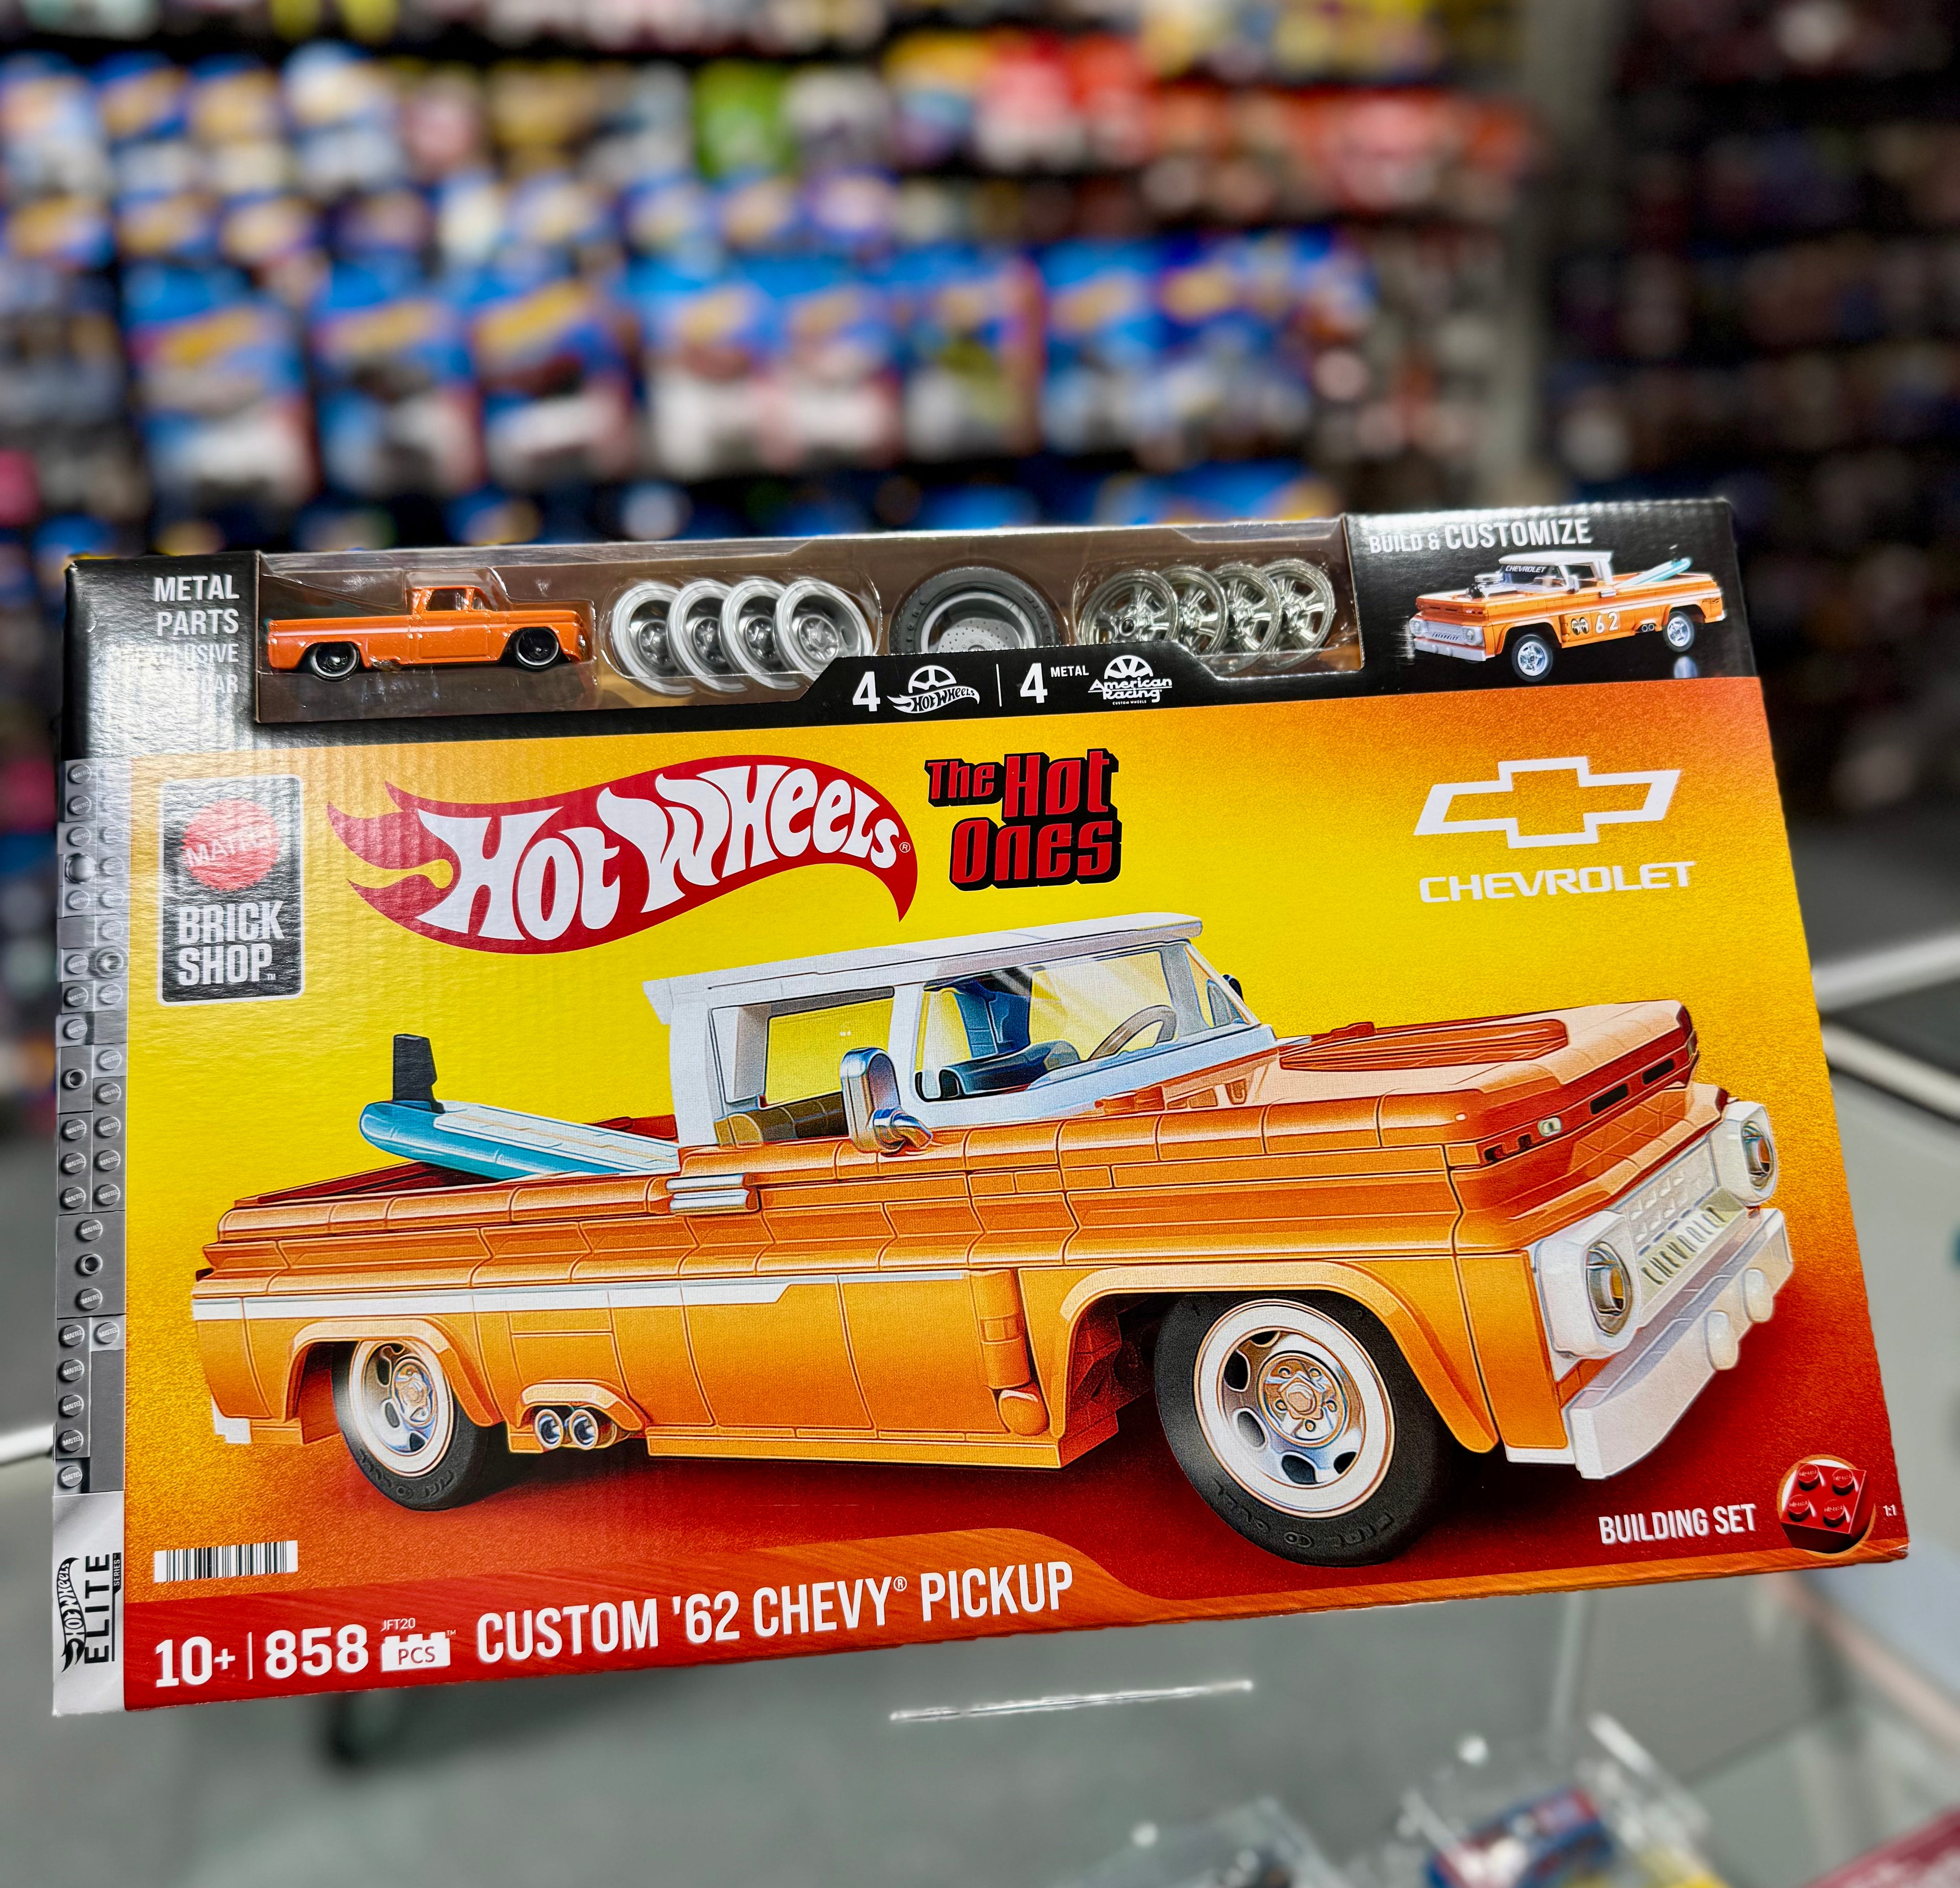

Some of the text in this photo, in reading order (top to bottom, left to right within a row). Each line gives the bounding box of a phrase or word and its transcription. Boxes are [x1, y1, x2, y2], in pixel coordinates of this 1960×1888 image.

[1368, 519, 1592, 553] BUILD & CUSTOMIZE
[1505, 565, 1547, 573] CHEVROLET
[154, 575, 239, 602] METAL
[157, 609, 239, 637] PARTS
[1595, 612, 1620, 634] 62
[201, 674, 239, 693] CAR
[852, 672, 880, 712] 4
[1020, 663, 1089, 703] 4 METAL
[1088, 677, 1173, 692] American
[1102, 687, 1161, 703] Racing
[926, 749, 1114, 818] The Hot
[185, 828, 274, 866] MATT
[951, 818, 1115, 885] Ones
[1419, 861, 1697, 903] CHEVROLET
[179, 901, 285, 944] BRICK
[1598, 1503, 1757, 1545] BUILDING SET
[84, 1554, 110, 1664] ELITE
[380, 1617, 416, 1632] JFT20
[477, 1598, 659, 1664] CUSTOM
[673, 1590, 741, 1645] '62
[920, 1560, 1073, 1622] PICKUP
[154, 1623, 369, 1688] 10+ 858
[398, 1646, 435, 1665] PCS
